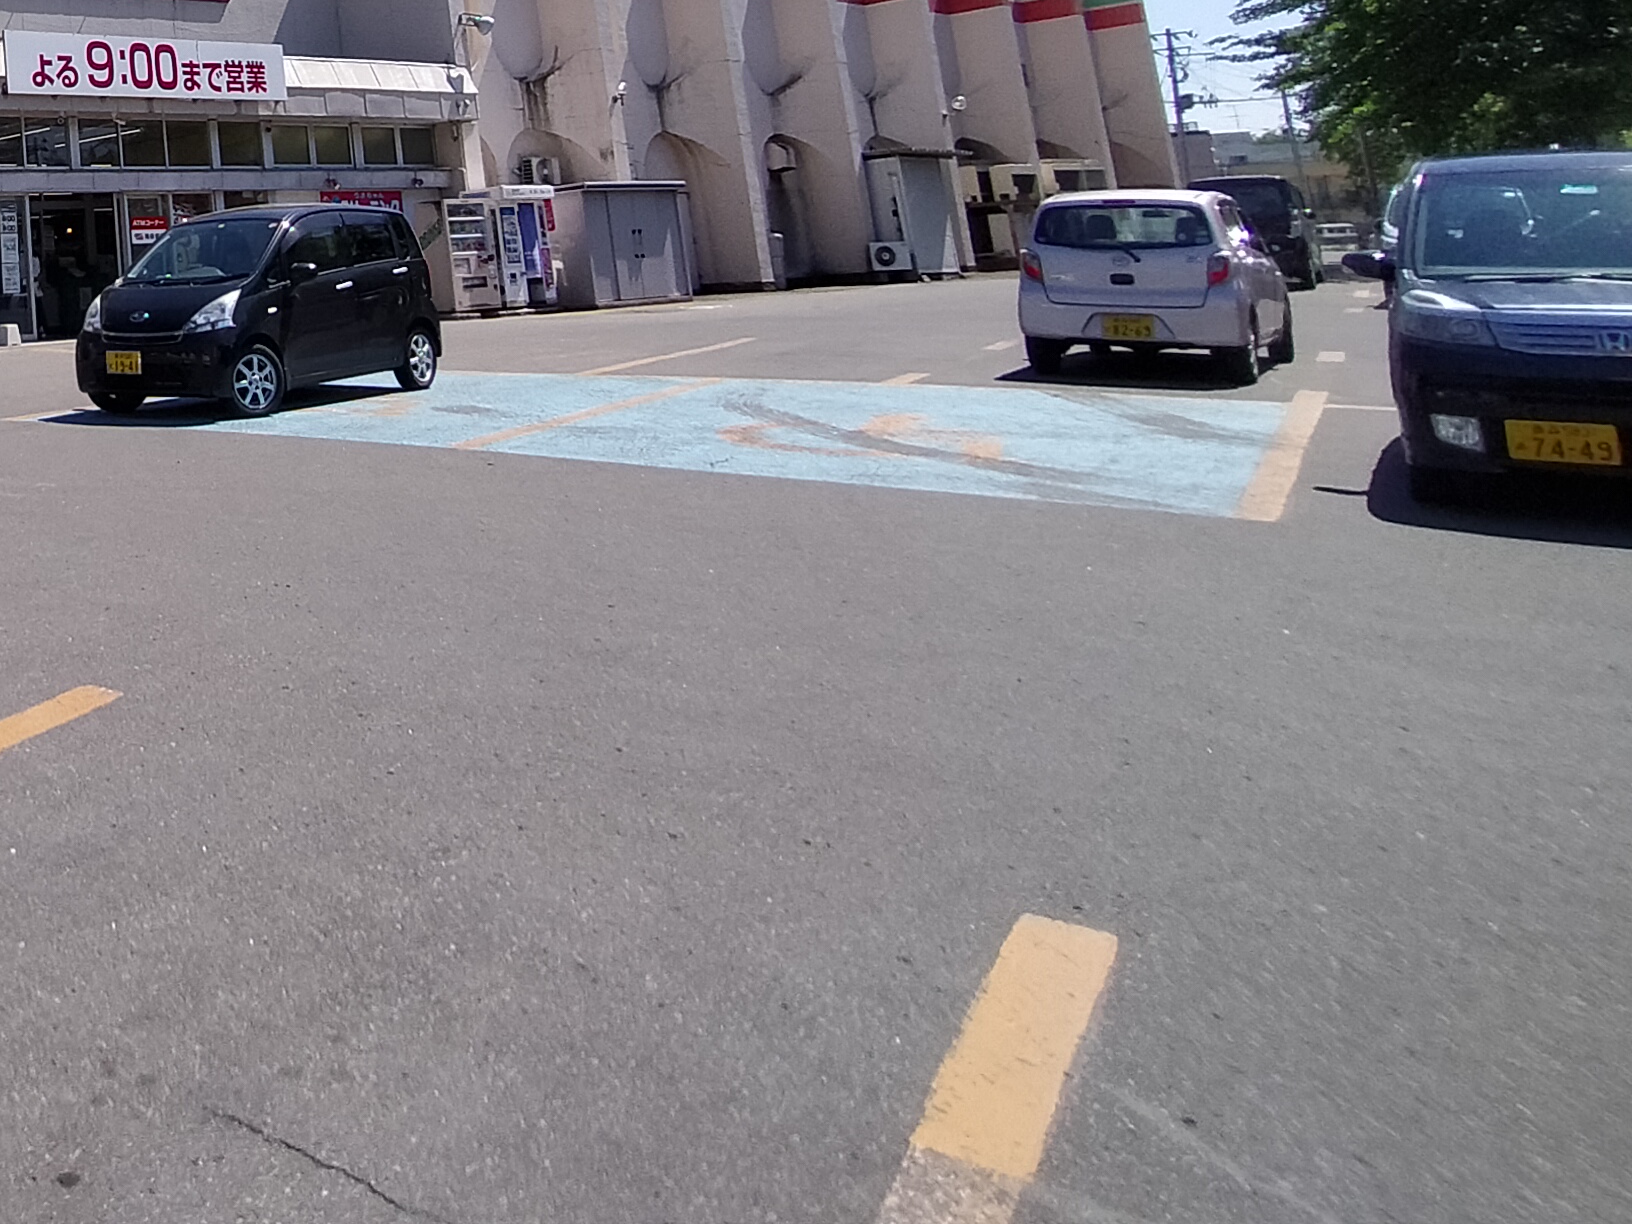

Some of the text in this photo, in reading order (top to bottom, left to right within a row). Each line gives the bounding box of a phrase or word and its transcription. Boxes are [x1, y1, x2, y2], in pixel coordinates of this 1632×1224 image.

[32, 40, 268, 94] よる9:00まで営業
[1533, 437, 1613, 461] 74-49
